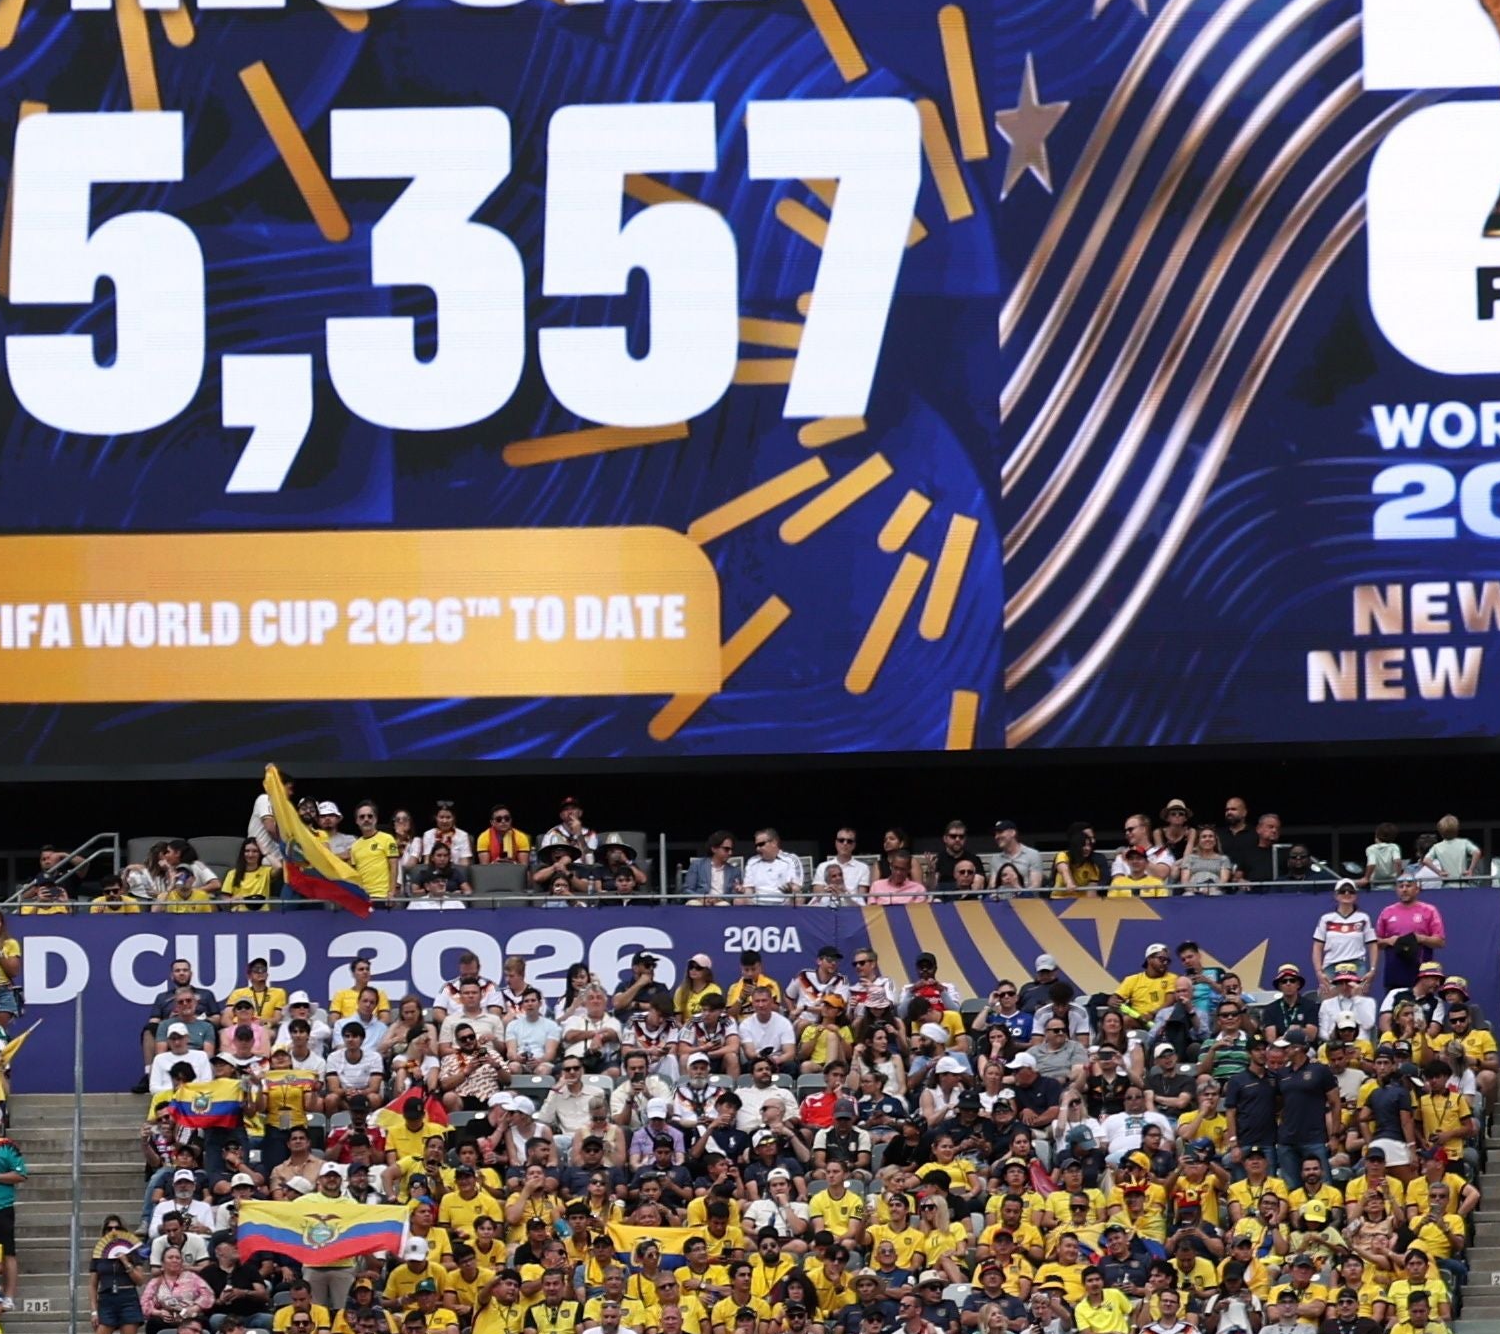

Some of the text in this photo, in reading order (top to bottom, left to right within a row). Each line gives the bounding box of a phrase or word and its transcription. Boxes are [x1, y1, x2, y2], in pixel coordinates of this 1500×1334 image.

[79, 600, 244, 649] WORLD
[248, 597, 342, 648] CUP
[507, 593, 570, 644] TO
[572, 593, 689, 643] DATE
[1306, 646, 1483, 703] NEW
[723, 925, 803, 954] 206A
[25, 1301, 49, 1313] 205
